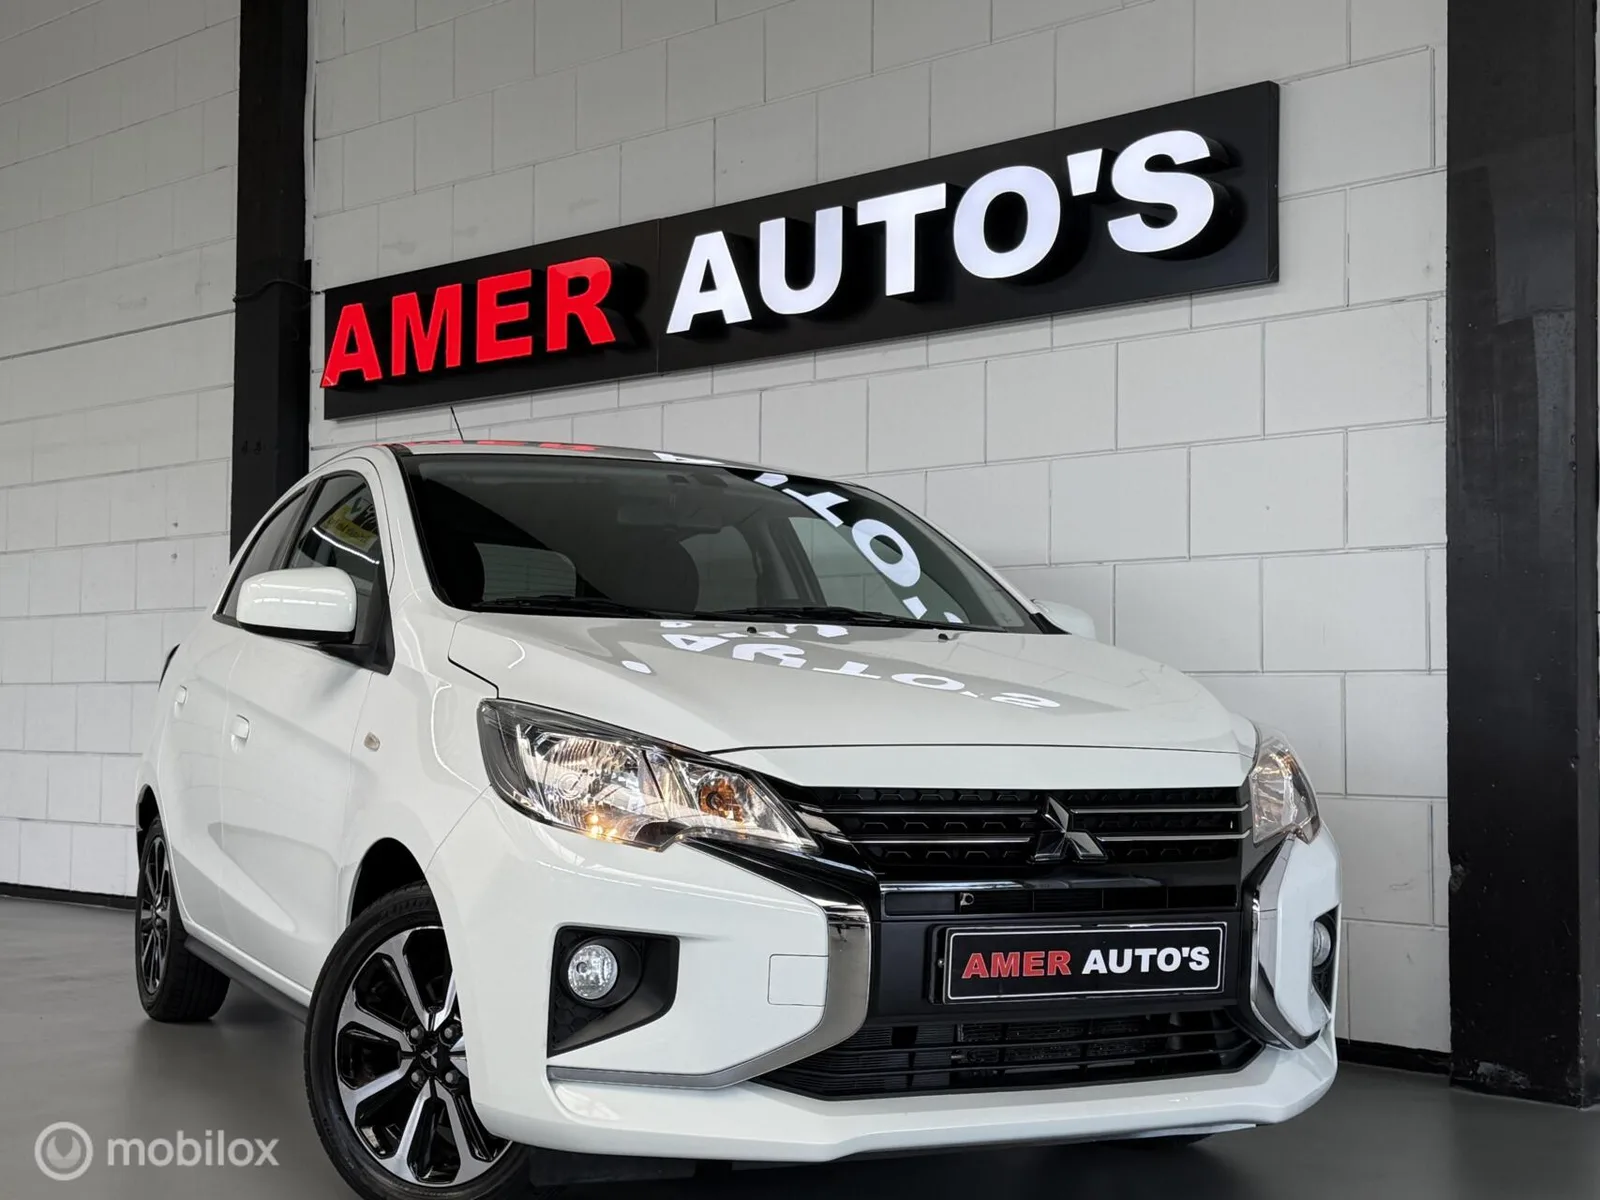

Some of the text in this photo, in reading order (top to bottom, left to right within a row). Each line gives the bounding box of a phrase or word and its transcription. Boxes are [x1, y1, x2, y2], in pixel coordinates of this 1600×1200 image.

[321, 130, 1215, 389] AMER AUTO'S
[961, 946, 1210, 979] AMER AUTO'S
